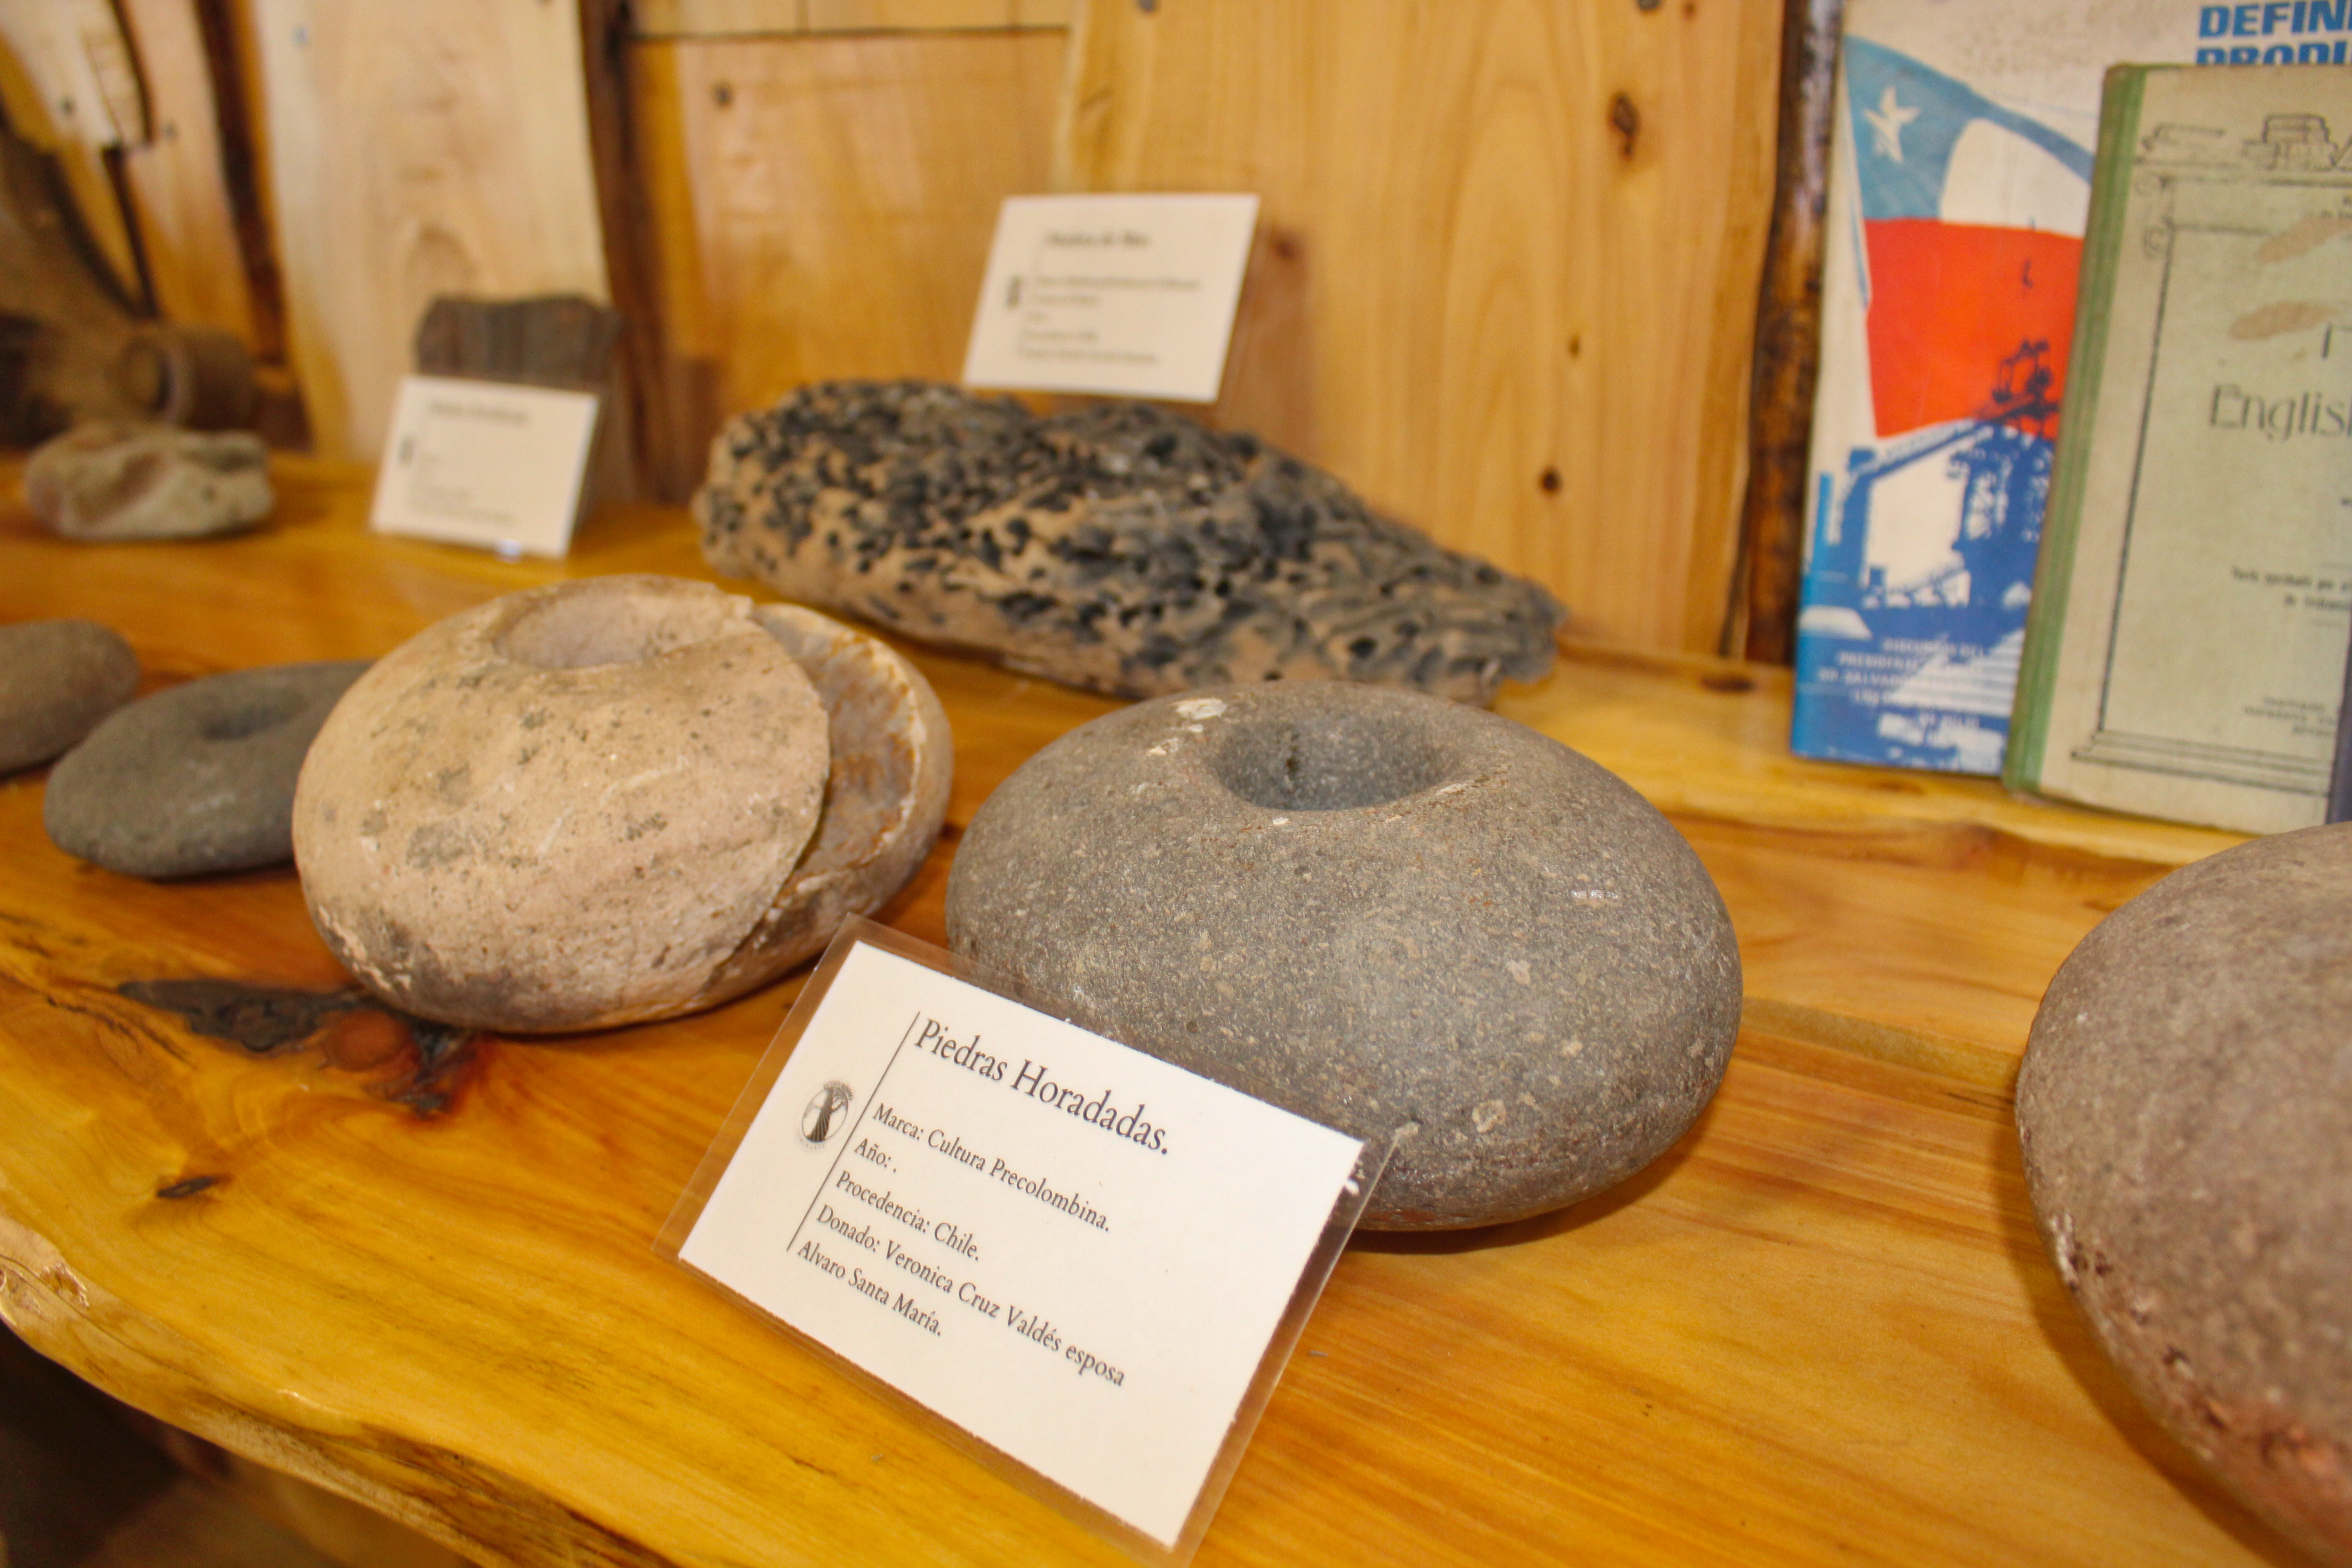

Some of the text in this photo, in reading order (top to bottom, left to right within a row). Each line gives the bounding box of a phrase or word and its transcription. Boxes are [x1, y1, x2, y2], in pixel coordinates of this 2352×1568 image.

[2210, 383, 2352, 451] Englis
[914, 1019, 1168, 1156] Piedras Horadadas.
[835, 1170, 979, 1261] Procedencia: Chile.
[872, 1103, 924, 1141] Marca:
[928, 1129, 986, 1171] Cultura
[989, 1158, 1109, 1232] Precolombina.
[797, 1240, 941, 1337] Alvaro Santa María.
[816, 1204, 1125, 1387] Donado: Veronica Cruz Valdés esposa
